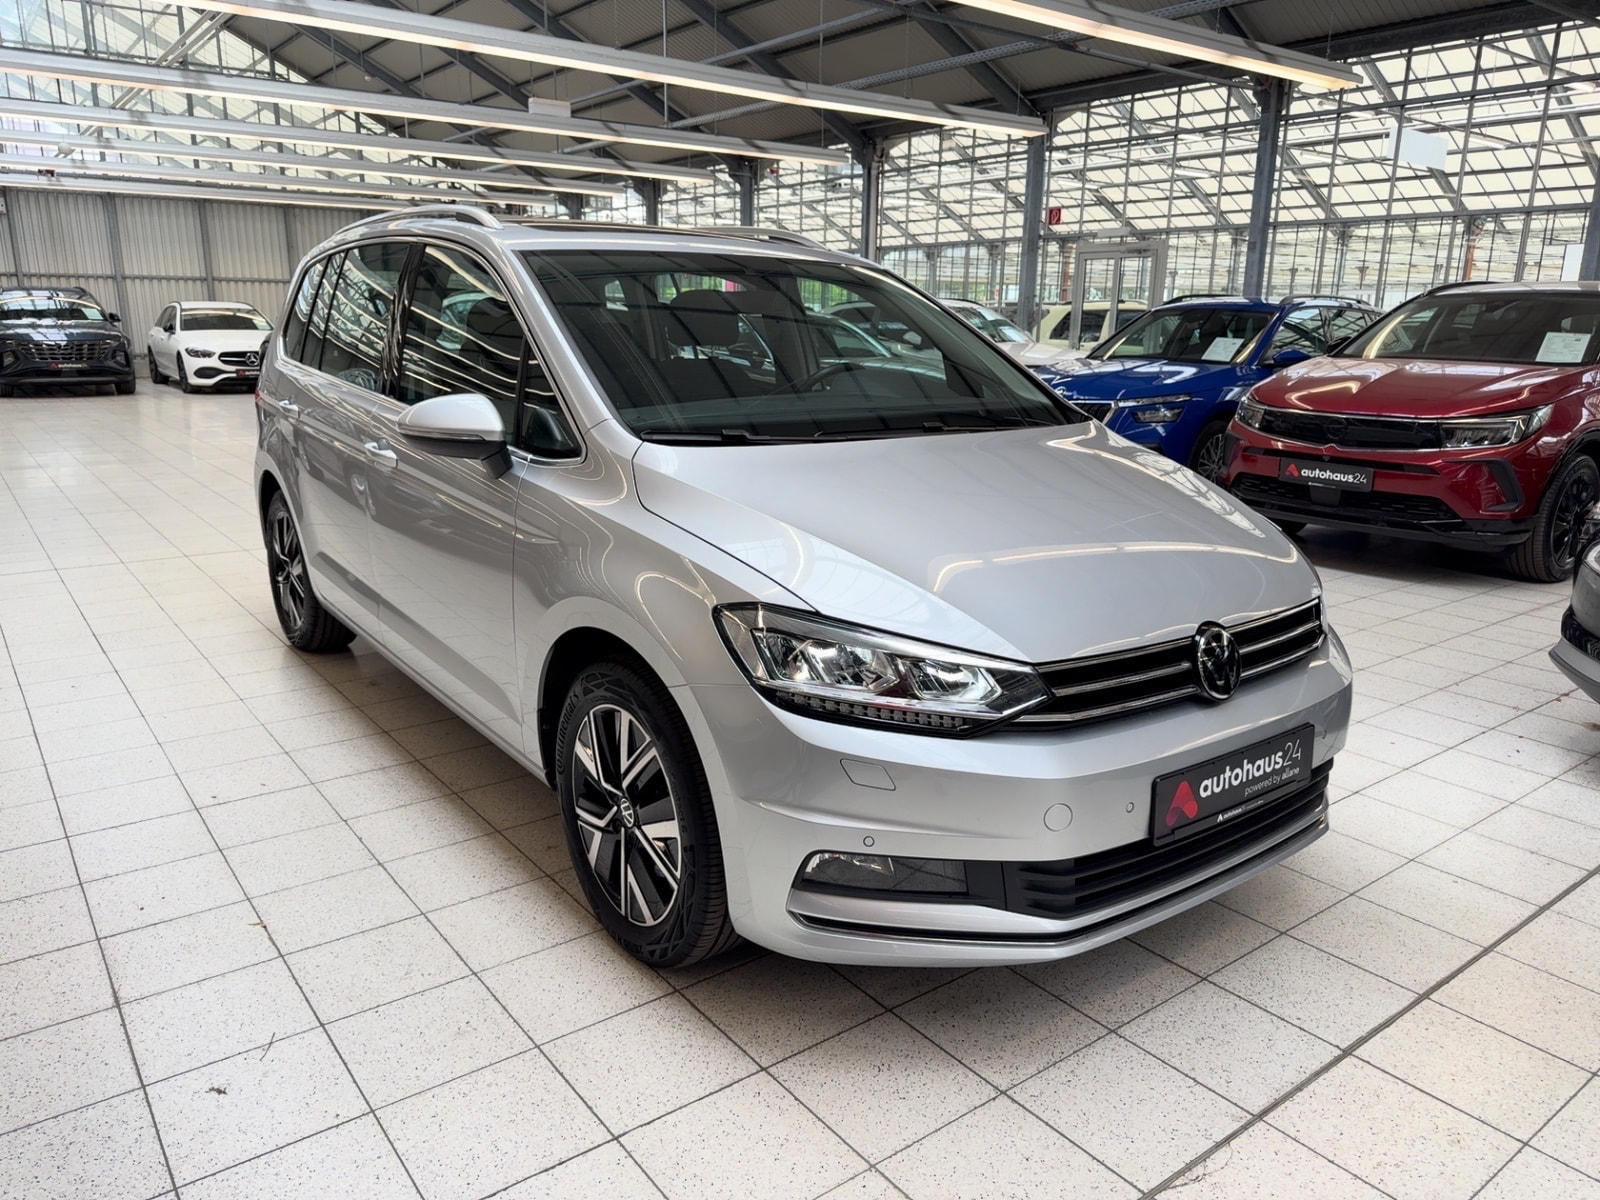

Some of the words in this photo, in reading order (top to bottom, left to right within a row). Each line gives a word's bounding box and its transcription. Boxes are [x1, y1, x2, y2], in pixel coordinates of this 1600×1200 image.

[1301, 468, 1367, 485] autohaus24
[1199, 739, 1302, 798] autohaus24
[1244, 776, 1273, 797] powered
[1273, 773, 1281, 784] by
[1281, 767, 1300, 780] allane
